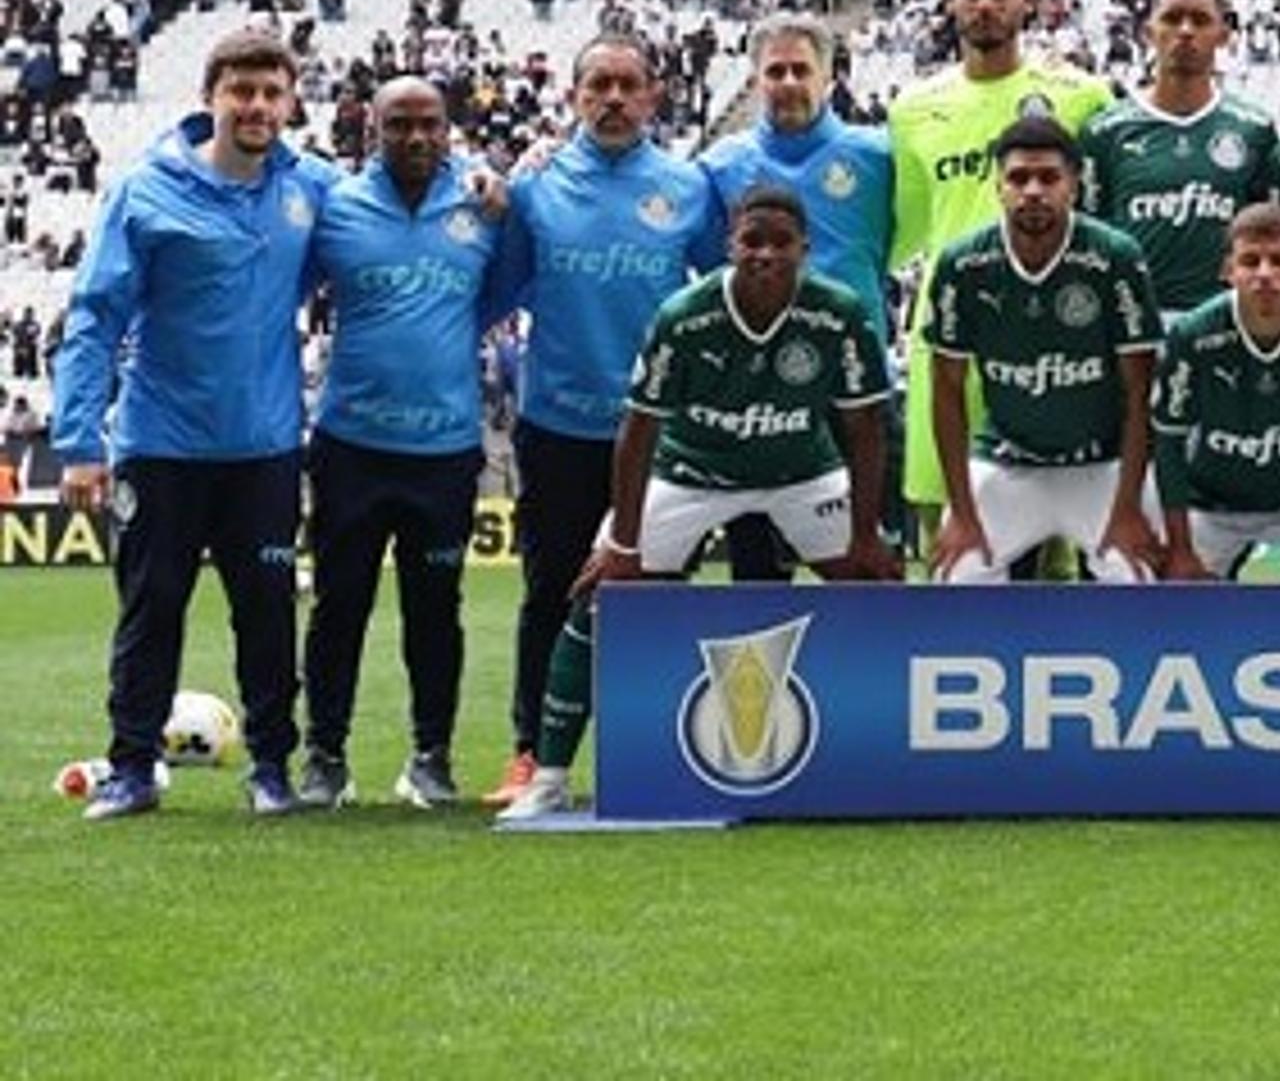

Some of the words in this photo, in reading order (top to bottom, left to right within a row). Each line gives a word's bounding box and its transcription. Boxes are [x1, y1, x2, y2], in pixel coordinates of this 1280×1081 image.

[1128, 181, 1235, 226] crefisa
[986, 353, 1104, 395] crefisa
[688, 403, 810, 440] crefisa
